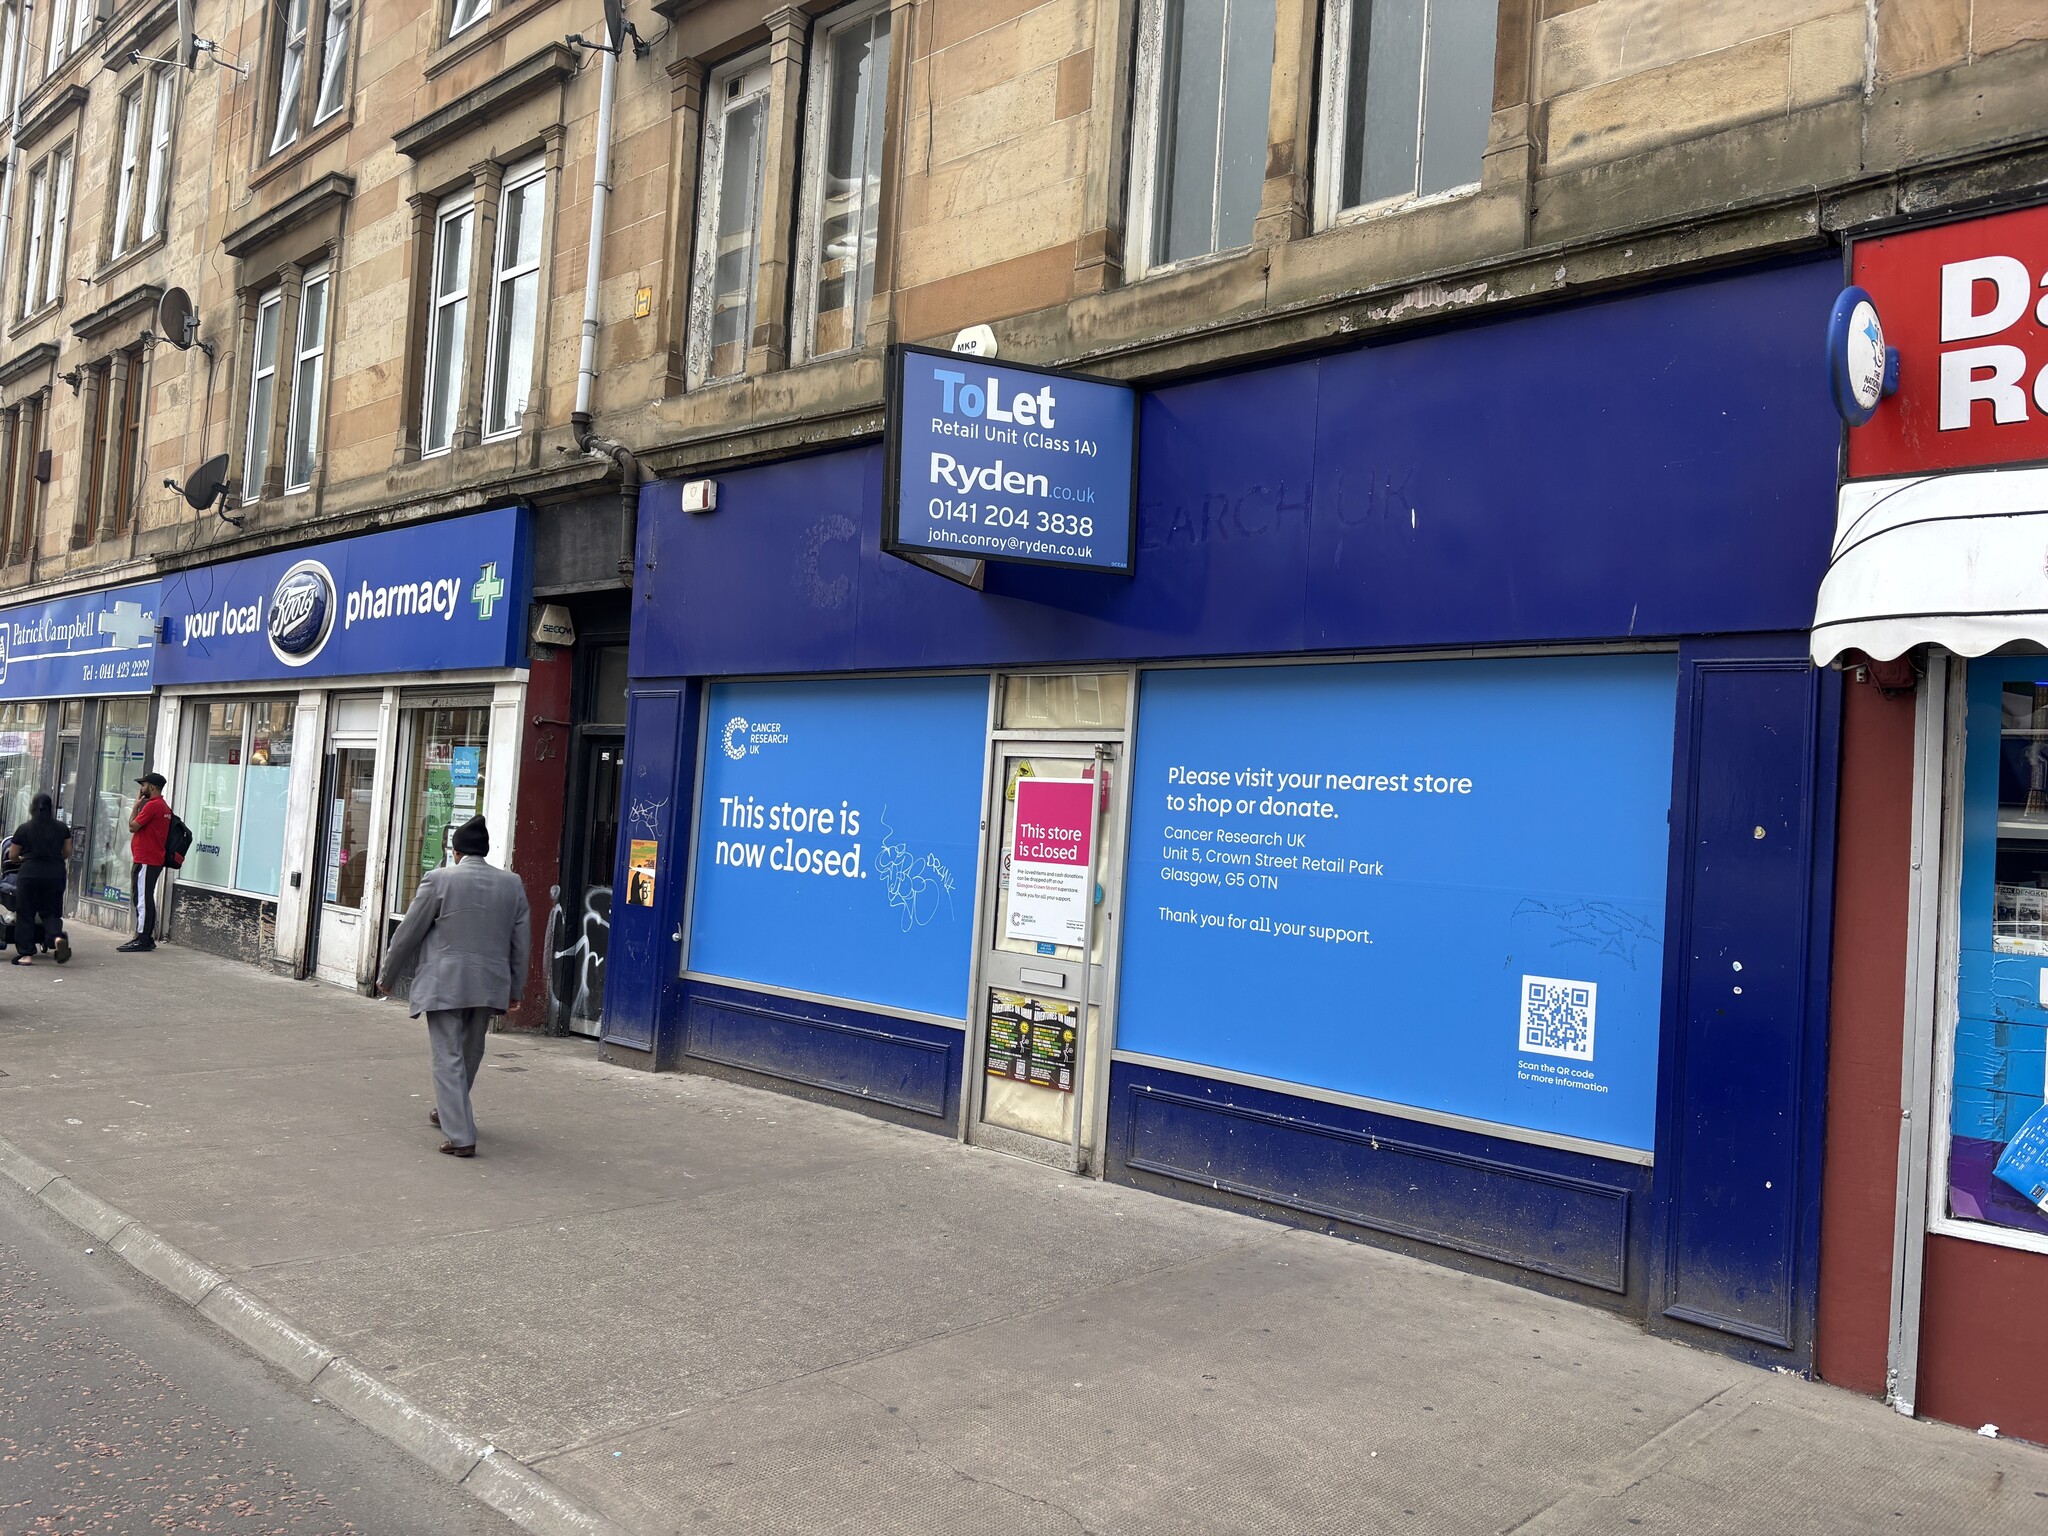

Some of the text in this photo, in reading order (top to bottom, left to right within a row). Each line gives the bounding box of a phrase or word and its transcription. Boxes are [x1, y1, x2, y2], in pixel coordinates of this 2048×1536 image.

[1940, 255, 2048, 343] D
[958, 341, 977, 352] MKD
[1938, 343, 2048, 432] R
[932, 418, 1097, 457] Retail Unit (Class 1A)
[929, 499, 1094, 537] 0141 204 3838
[1143, 476, 1313, 550] EARCH
[928, 528, 1093, 558] john.conroy@ryden.co.uk
[183, 612, 220, 647] your
[222, 596, 262, 635] local
[269, 585, 318, 638] Boots
[345, 577, 461, 630] pharmacy
[13, 620, 43, 646] Patrick
[45, 612, 95, 649] Campbell
[543, 624, 572, 636] SECOM
[100, 662, 115, 680] 0141
[117, 661, 130, 678] 423
[132, 660, 150, 678] 2222
[751, 734, 789, 744] RESEARCH
[752, 723, 781, 733] CANCER
[750, 745, 760, 755] UK
[1169, 767, 1473, 794] Please visit your nearest store
[720, 796, 861, 836] This store is
[1167, 793, 1339, 819] to shop or donate.
[1021, 824, 1082, 842] This store
[1164, 826, 1307, 848] Cancer Research UK
[196, 842, 221, 857] pharmacy
[716, 838, 868, 879] now closed.
[1019, 841, 1078, 861] is closed
[1163, 846, 1384, 876] Unit 5, Crown Street Retail Park
[1161, 867, 1222, 887] Glasgow,
[1225, 873, 1245, 887] G5
[1159, 907, 1374, 944] Thank you for all your support.
[1518, 1071, 1608, 1093] for more information
[1519, 1060, 1595, 1079] Scan the QR code
